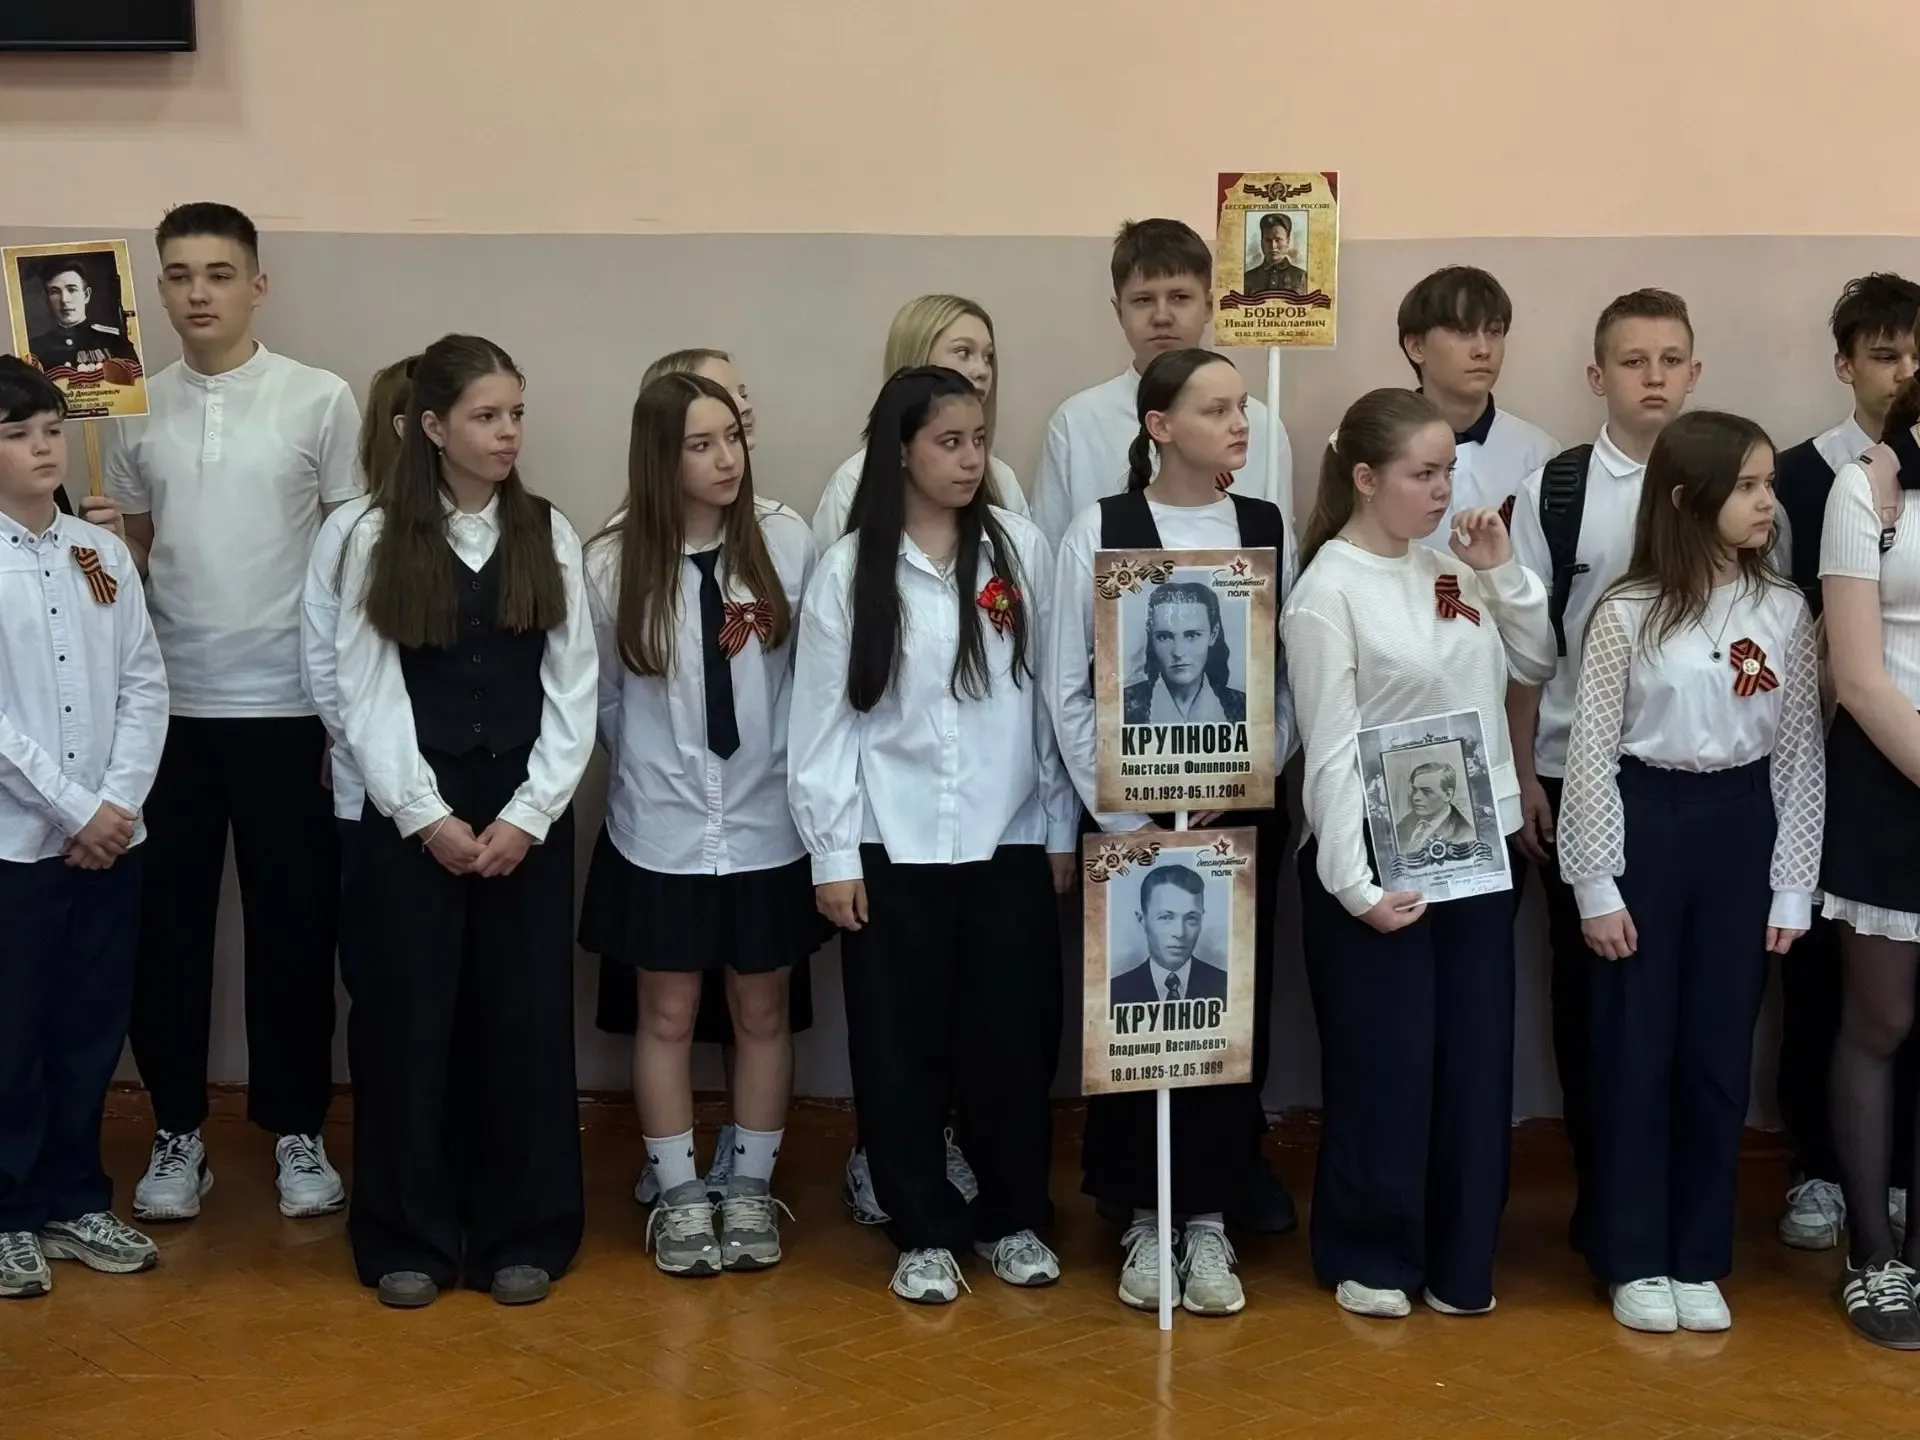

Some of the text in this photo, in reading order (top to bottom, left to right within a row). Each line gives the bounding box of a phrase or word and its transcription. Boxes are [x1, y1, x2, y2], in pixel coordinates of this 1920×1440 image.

[1243, 307, 1307, 318] БОБРОВ
[1225, 319, 1326, 328] Иван Николаевич
[1121, 724, 1249, 756] КРУПНОВА
[1120, 760, 1250, 776] Анастасия Филипповна
[1124, 784, 1246, 801] 24.01.1923-05.11.2004
[1116, 1000, 1221, 1035] КРУПНОВ
[1109, 1038, 1226, 1057] Владимир Васильевич
[1110, 1060, 1224, 1082] 18.01.1925-12.05.1969
